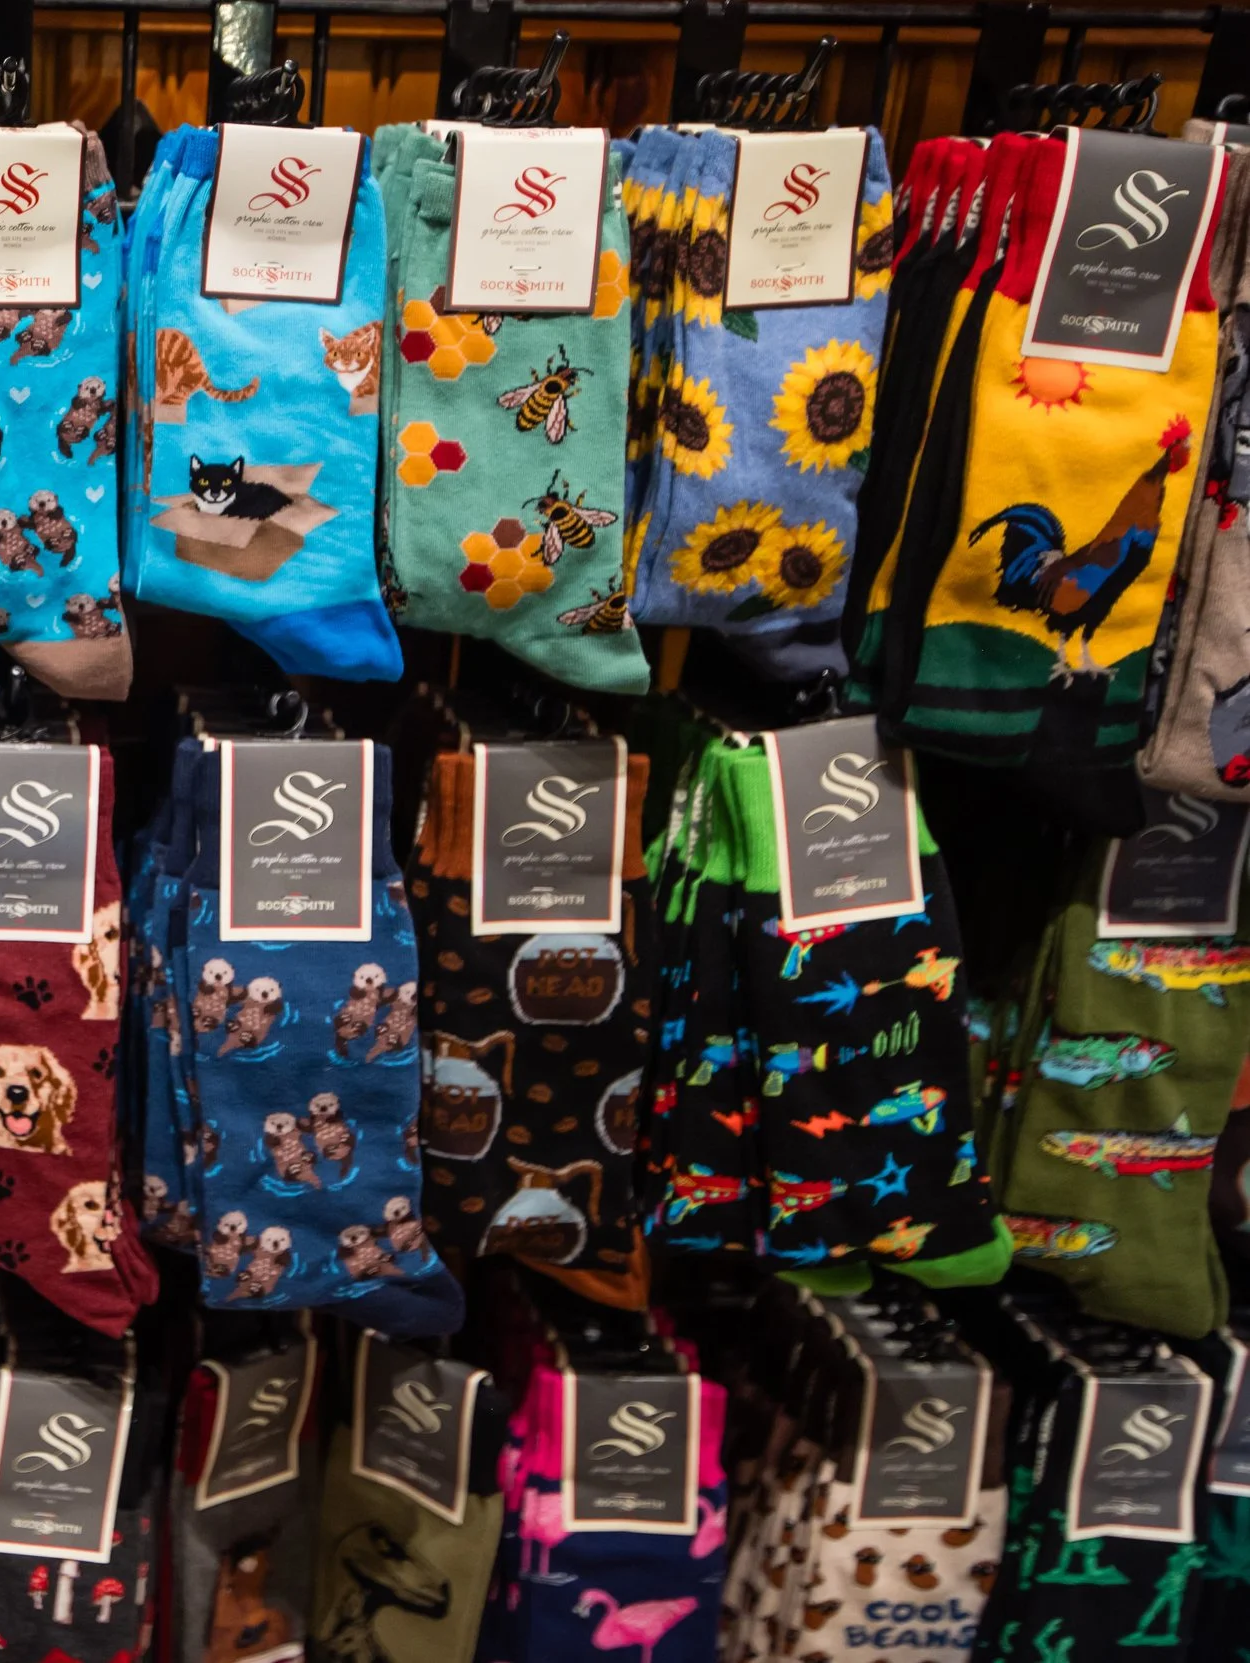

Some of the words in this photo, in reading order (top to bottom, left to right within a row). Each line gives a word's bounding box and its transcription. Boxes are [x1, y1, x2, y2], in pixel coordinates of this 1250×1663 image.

[8, 222, 34, 232] cotton
[234, 212, 271, 227] graphic
[274, 216, 300, 226] cotton
[302, 219, 324, 227] crew
[480, 224, 518, 240] graphic
[521, 226, 549, 235] cotton
[750, 222, 784, 239] graphic
[787, 221, 811, 232] cotton
[1069, 261, 1109, 277] graphic
[1109, 266, 1137, 278] cotton
[1138, 271, 1161, 281] crew
[1060, 314, 1140, 333] SOCKSMITH
[250, 852, 290, 868] graphic
[290, 853, 318, 864] cotton
[256, 899, 335, 915] SOCKSMITH
[538, 947, 598, 968] POT
[526, 975, 605, 997] HEAD
[865, 1599, 971, 1623] COOL
[843, 1625, 978, 1648] BEANS
